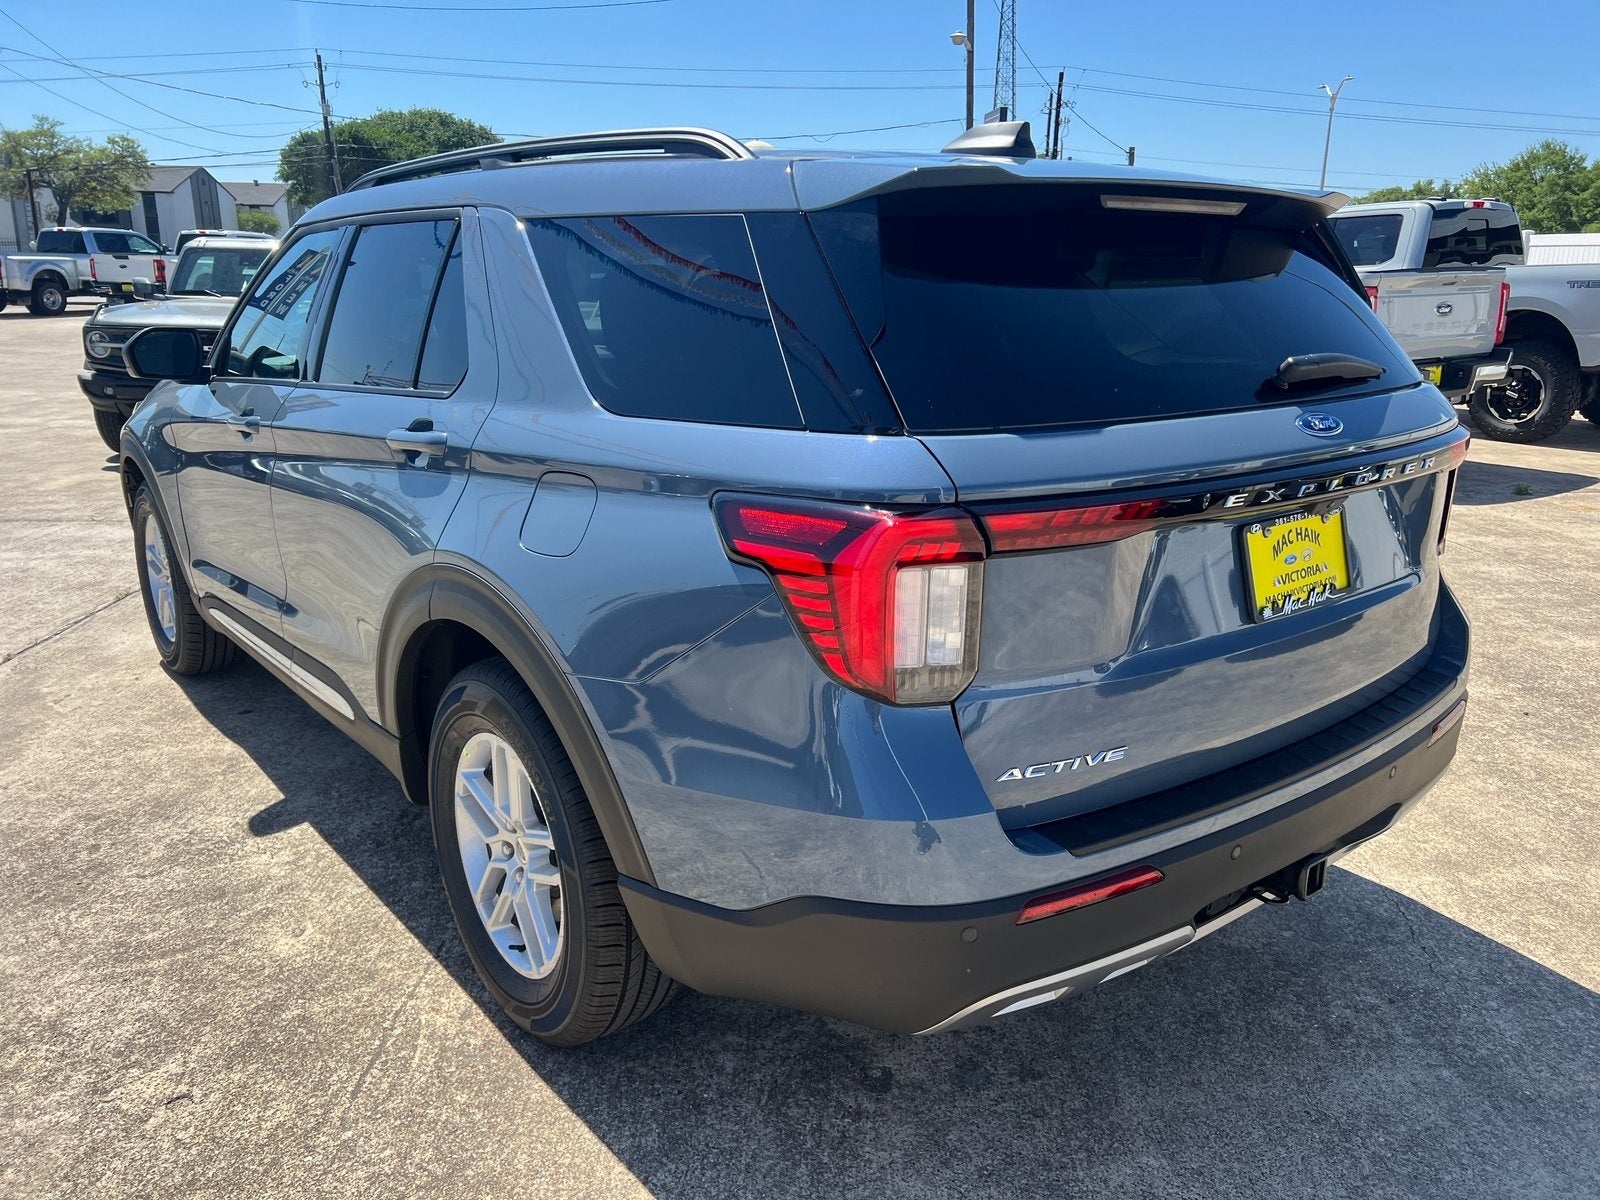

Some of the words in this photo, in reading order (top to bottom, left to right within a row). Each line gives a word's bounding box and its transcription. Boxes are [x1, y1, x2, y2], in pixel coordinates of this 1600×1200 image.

[1308, 415, 1337, 431] Ford
[1223, 457, 1436, 508] EXPLORER
[1272, 529, 1294, 560] MAC
[1295, 527, 1321, 547] HAIK
[1280, 564, 1321, 586] VICTORIA
[1284, 595, 1306, 616] Mac
[995, 746, 1129, 782] ACTIVE
